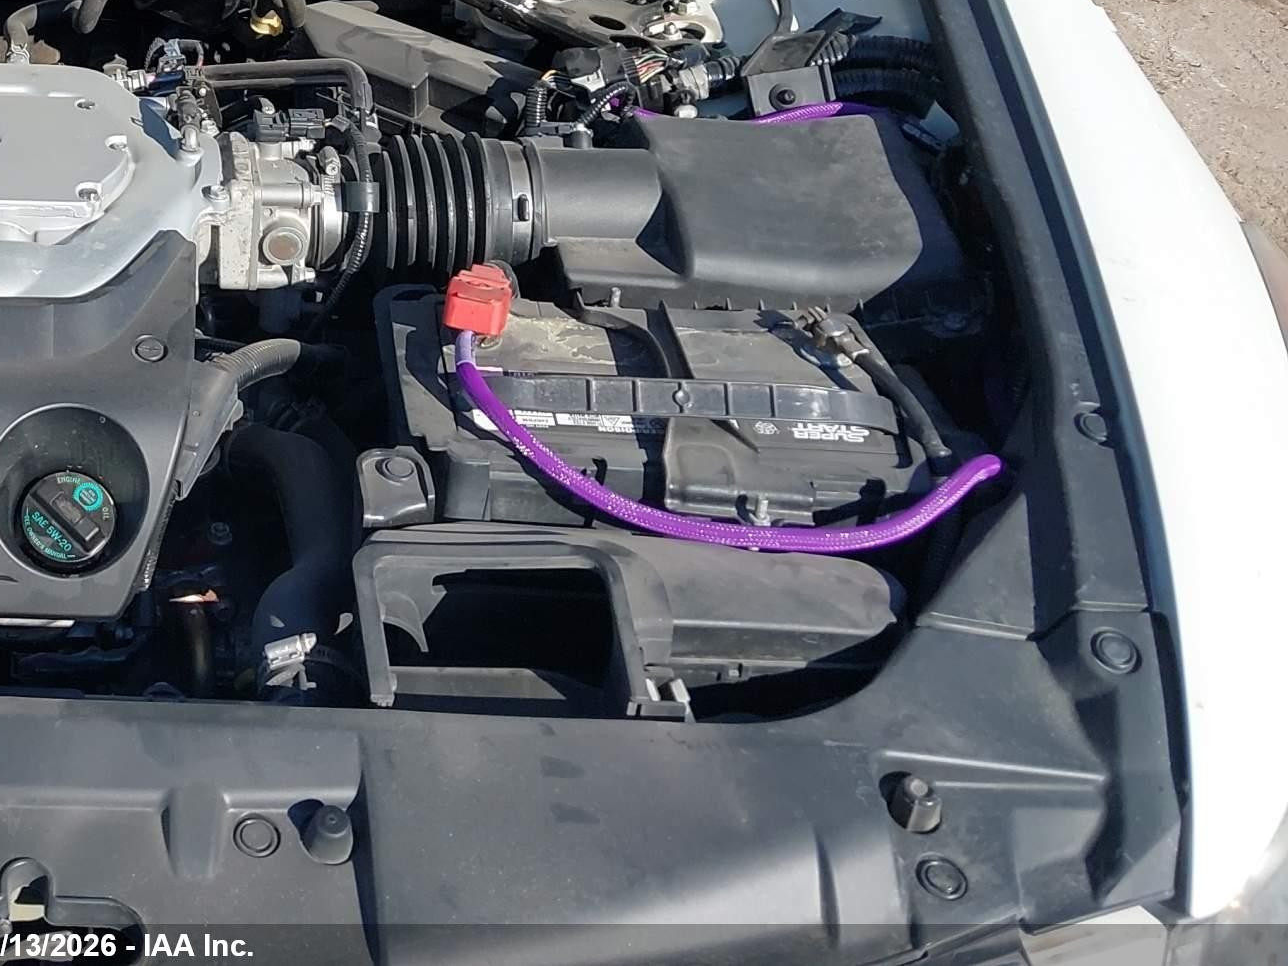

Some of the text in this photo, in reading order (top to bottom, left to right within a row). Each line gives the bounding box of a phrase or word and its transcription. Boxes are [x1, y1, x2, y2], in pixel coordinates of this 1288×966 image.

[792, 422, 870, 437] START
[793, 429, 866, 443] SUPER
[57, 475, 110, 520] ENGINE OIL
[31, 511, 73, 552] SAE 5W-20
[45, 547, 67, 559] MANUAL
